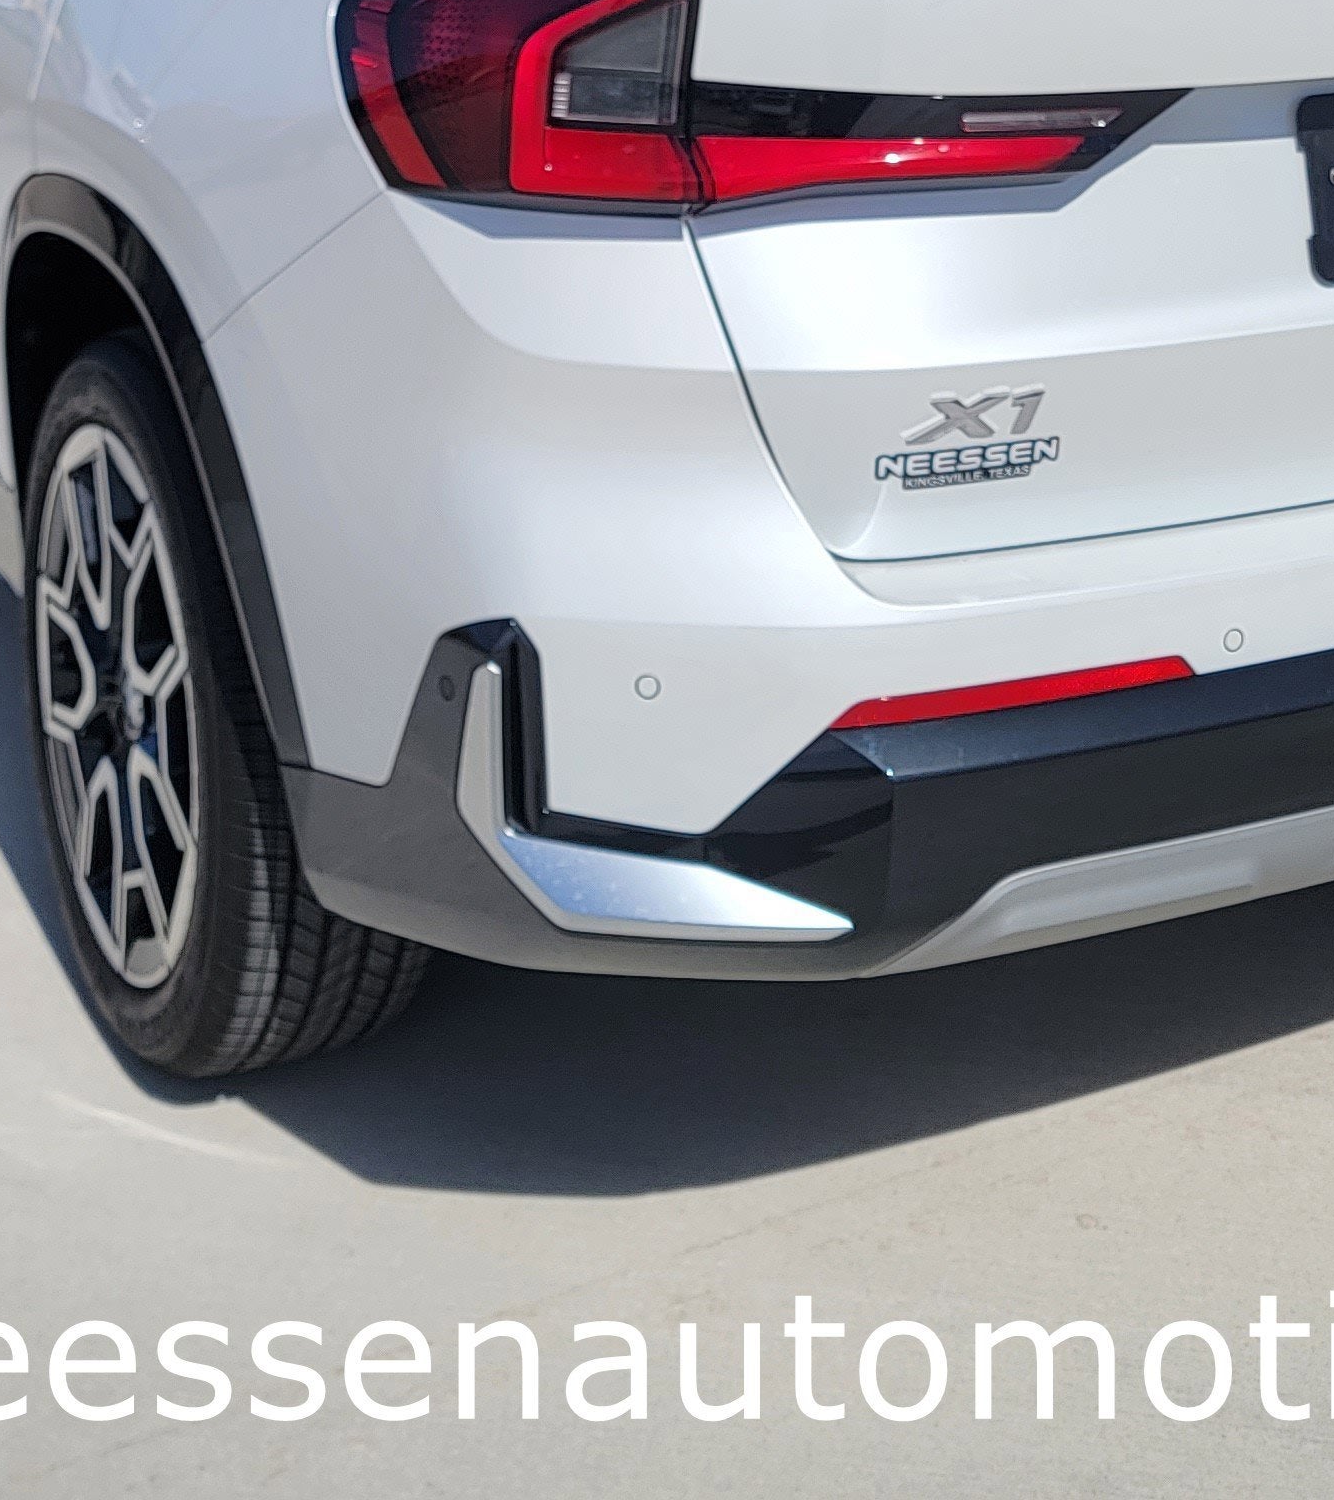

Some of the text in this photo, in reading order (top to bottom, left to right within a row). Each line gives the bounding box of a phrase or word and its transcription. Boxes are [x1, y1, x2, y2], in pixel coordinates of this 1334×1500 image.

[901, 384, 1045, 445] X1
[876, 437, 1059, 479] NEESSEN
[988, 464, 1030, 479] TEXAS
